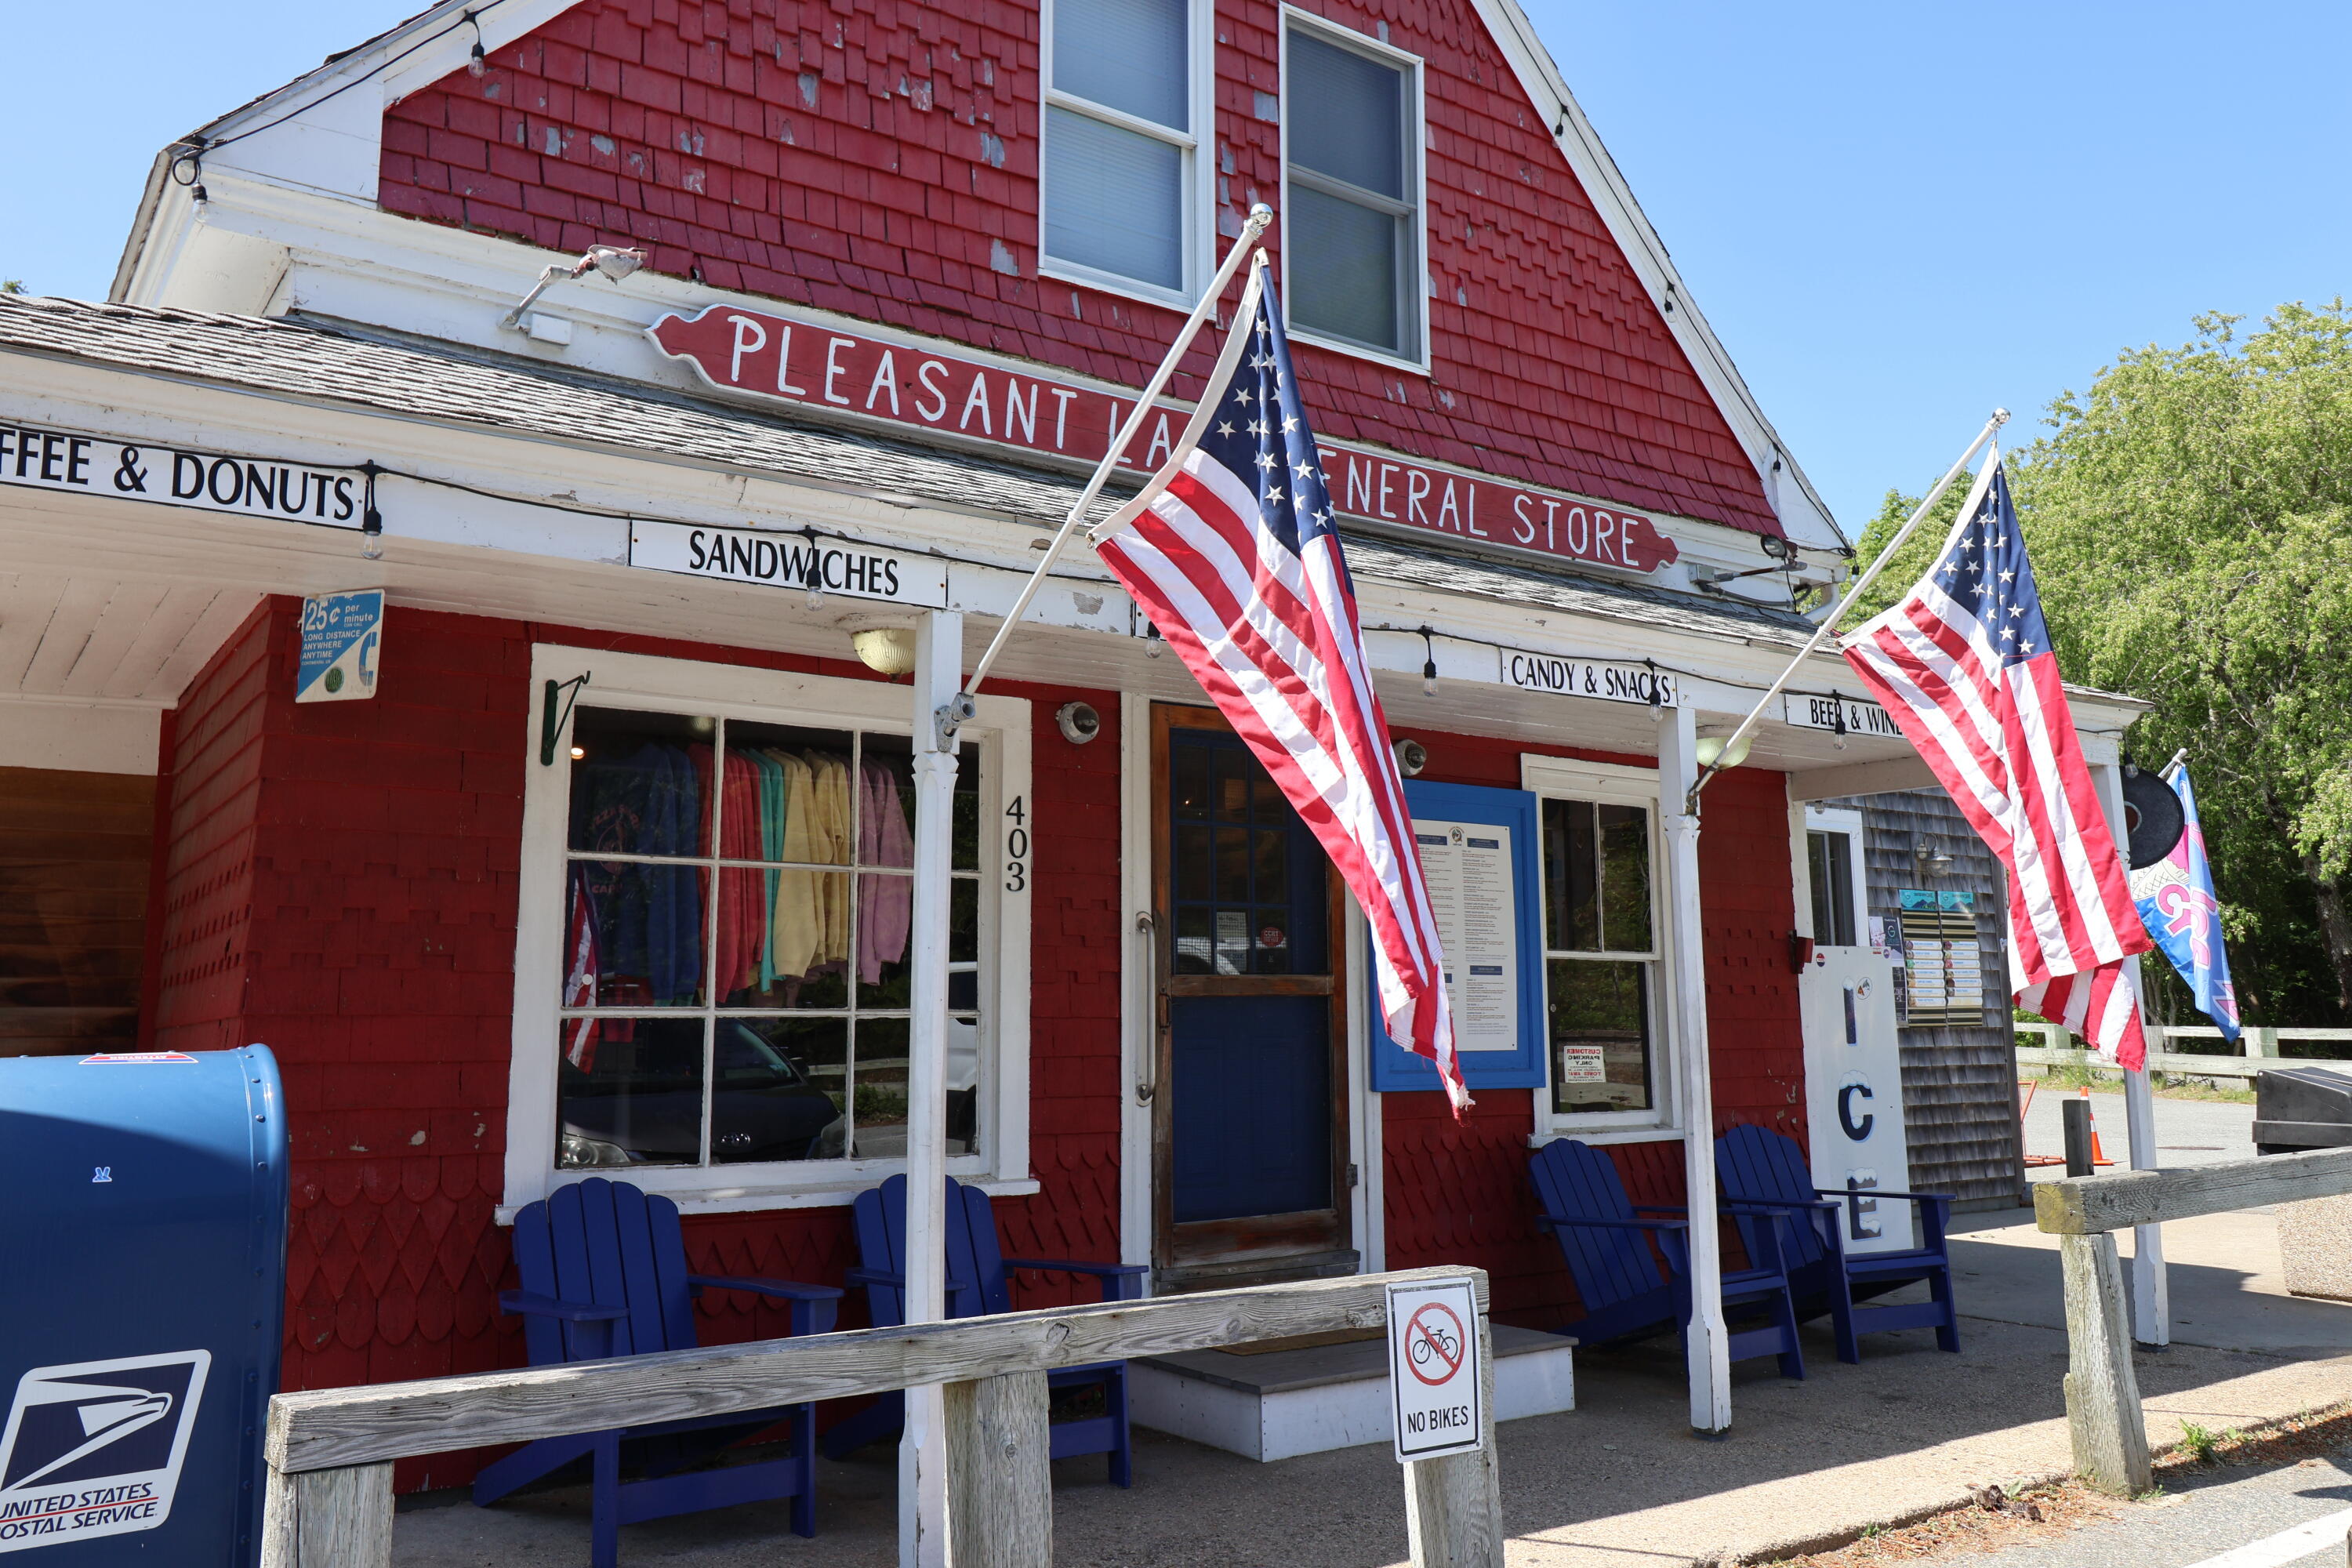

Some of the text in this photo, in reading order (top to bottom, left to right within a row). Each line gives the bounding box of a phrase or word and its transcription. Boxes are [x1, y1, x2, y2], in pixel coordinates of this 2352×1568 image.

[727, 314, 1077, 450] PLEASANT
[1108, 401, 1172, 468] LA
[1512, 494, 1639, 567] STORE
[114, 446, 148, 493] &
[172, 452, 354, 521] DONUTS
[689, 530, 899, 597] SANDWICHES
[344, 613, 374, 623] minute
[345, 604, 361, 614] per
[303, 630, 361, 641] LONG DISTANCE
[303, 641, 343, 650] ANYWHERE
[302, 650, 333, 659] ANYTIME
[1511, 655, 1575, 691] CANDY
[1584, 665, 1598, 694] &
[1850, 705, 1861, 730] &
[1006, 795, 1028, 892] 403
[1838, 976, 1882, 1240] ICE
[1407, 1406, 1468, 1434] NO BIKES
[78, 1482, 153, 1508] STATES
[0, 1501, 158, 1540] OSTAL SERVICE
